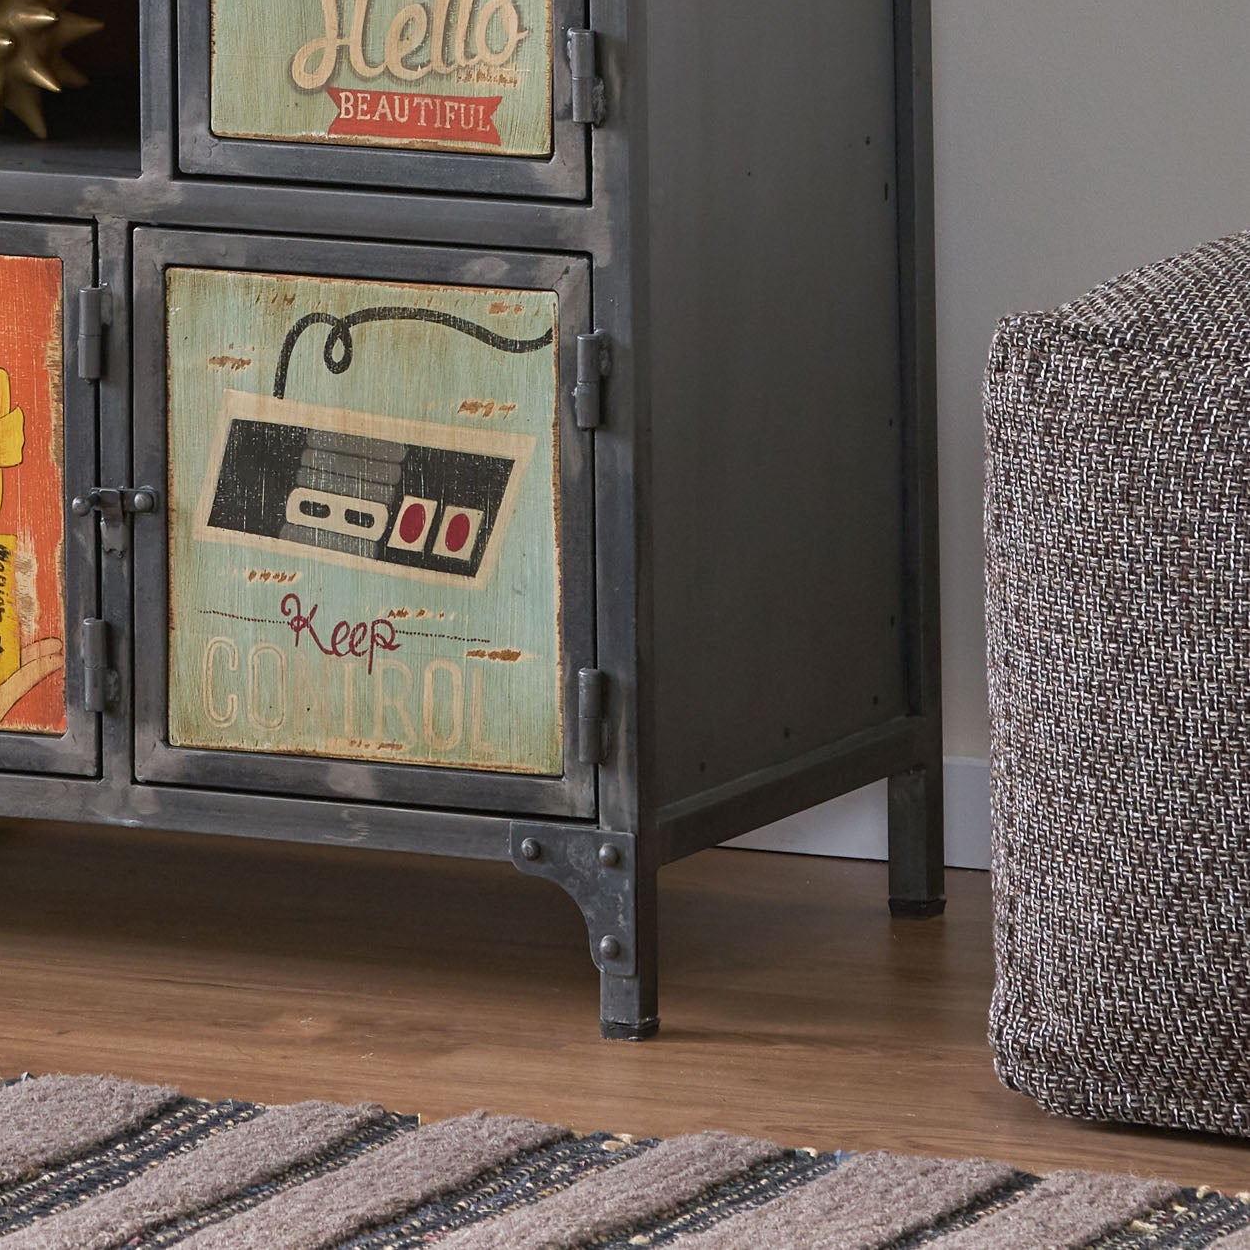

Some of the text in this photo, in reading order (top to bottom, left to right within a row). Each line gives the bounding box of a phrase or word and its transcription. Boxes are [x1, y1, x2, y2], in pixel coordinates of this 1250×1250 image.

[337, 91, 491, 133] BEAUTIFUL
[281, 593, 402, 675] Keep
[203, 636, 495, 750] CONTROL
